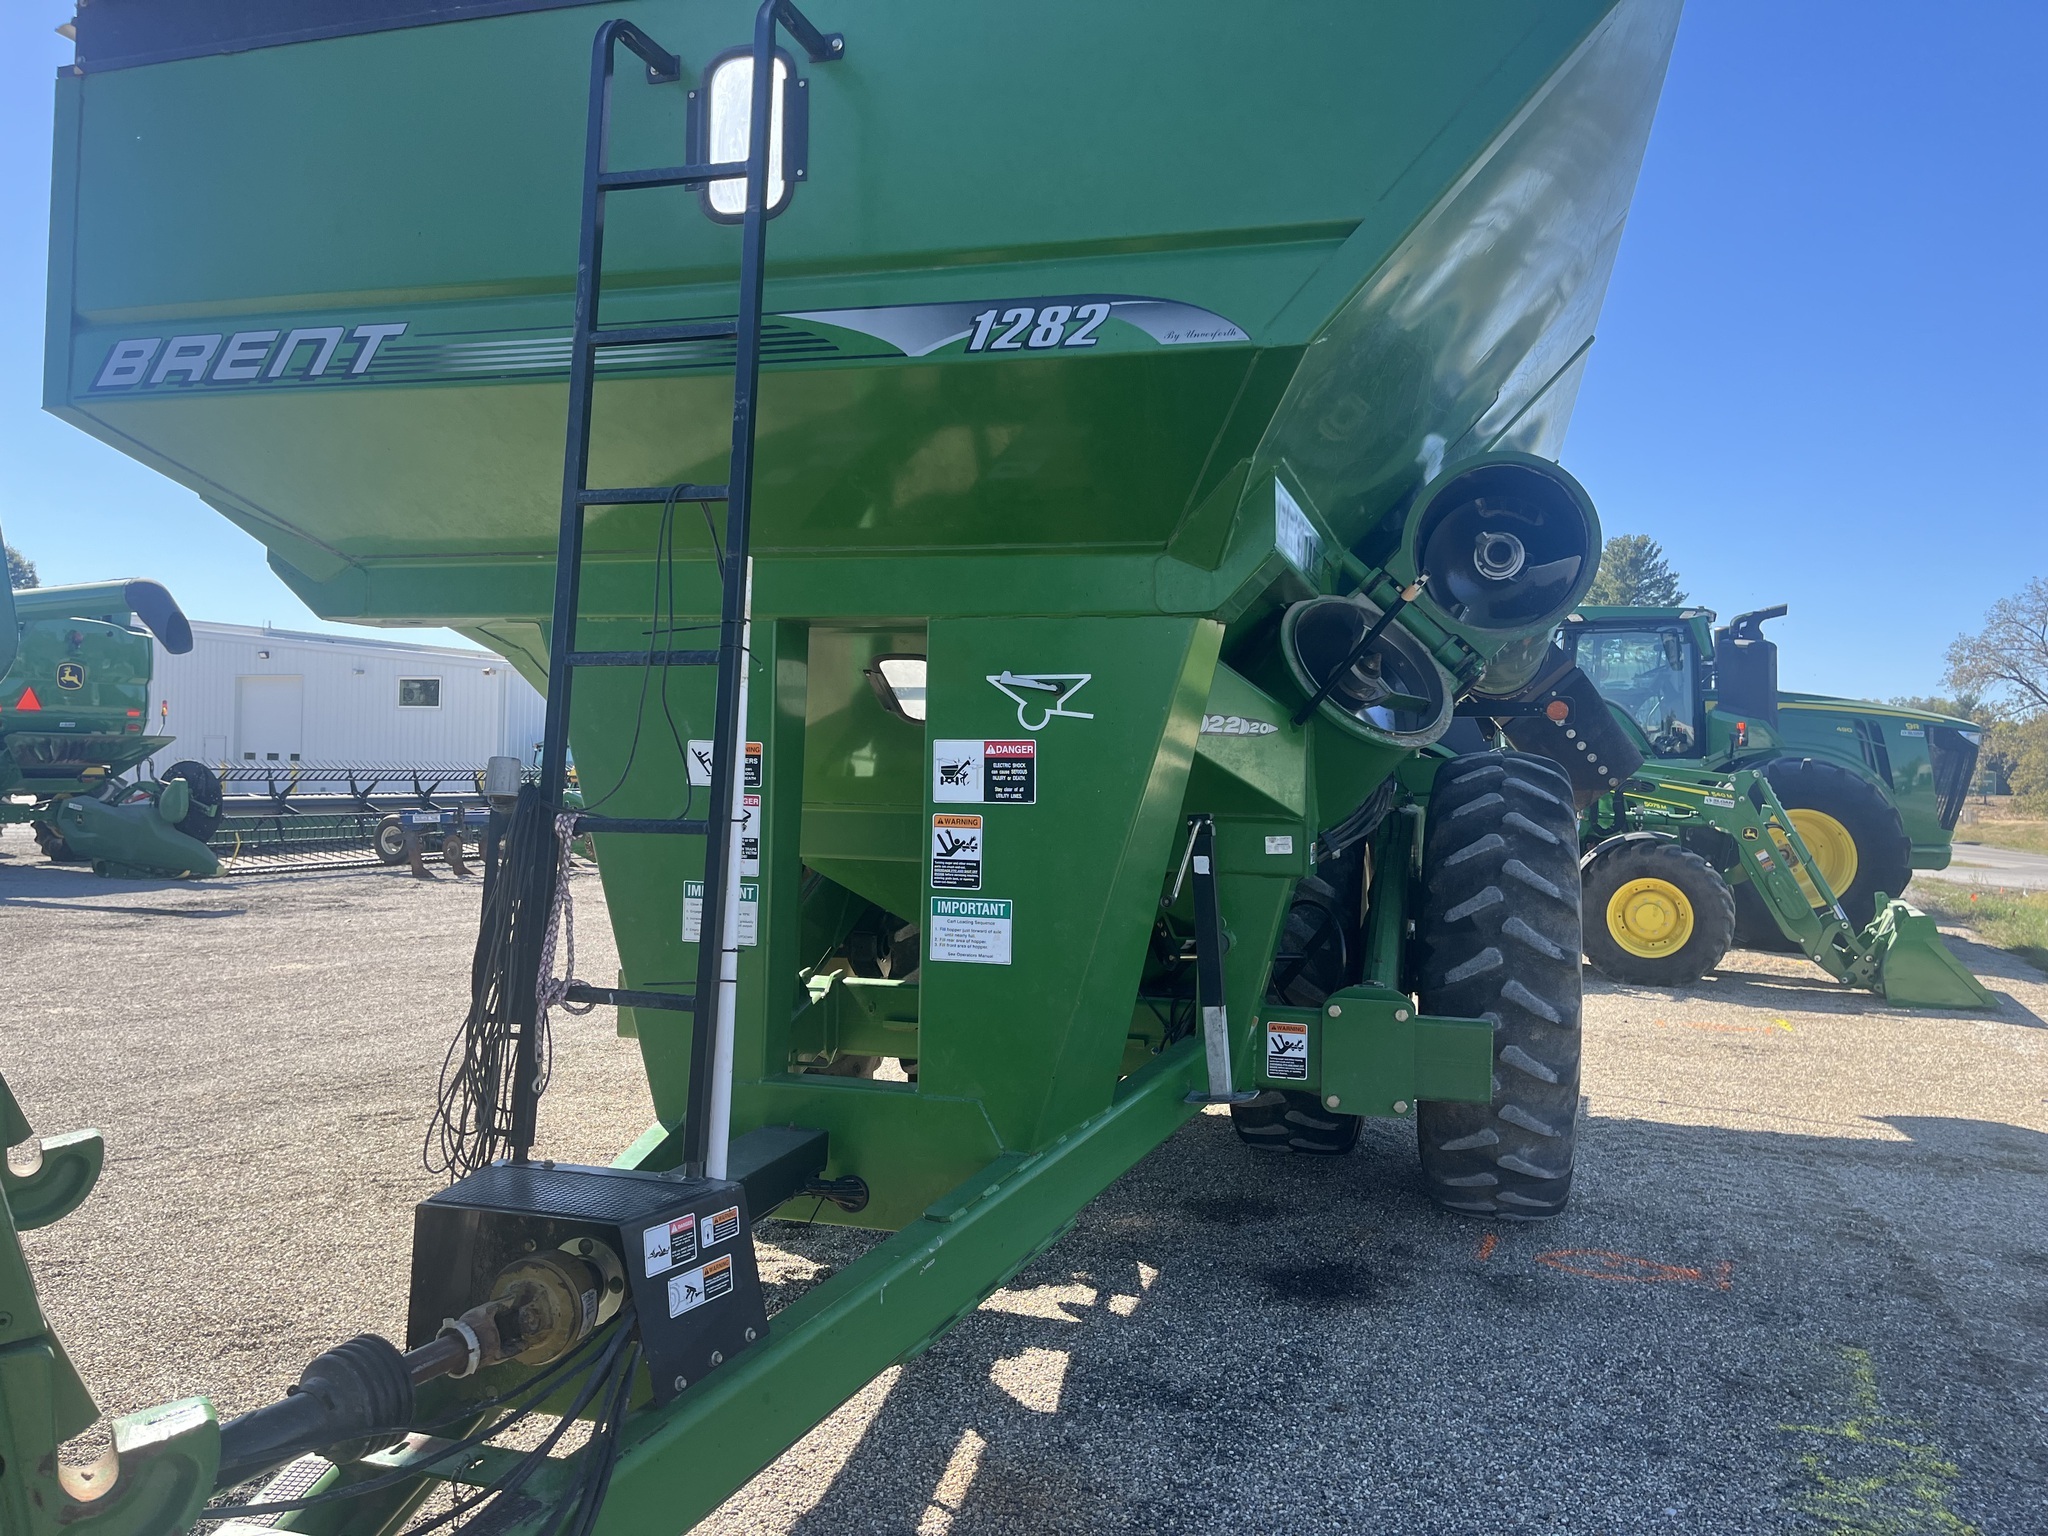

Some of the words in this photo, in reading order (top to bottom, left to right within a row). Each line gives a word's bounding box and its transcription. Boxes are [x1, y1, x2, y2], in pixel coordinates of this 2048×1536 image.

[966, 303, 1110, 352] 1282
[1164, 330, 1179, 342] By
[92, 322, 409, 389] BRENT
[996, 746, 1034, 754] DANGER
[938, 901, 1005, 916] IMPORTANT
[709, 1260, 730, 1272] WARNING
